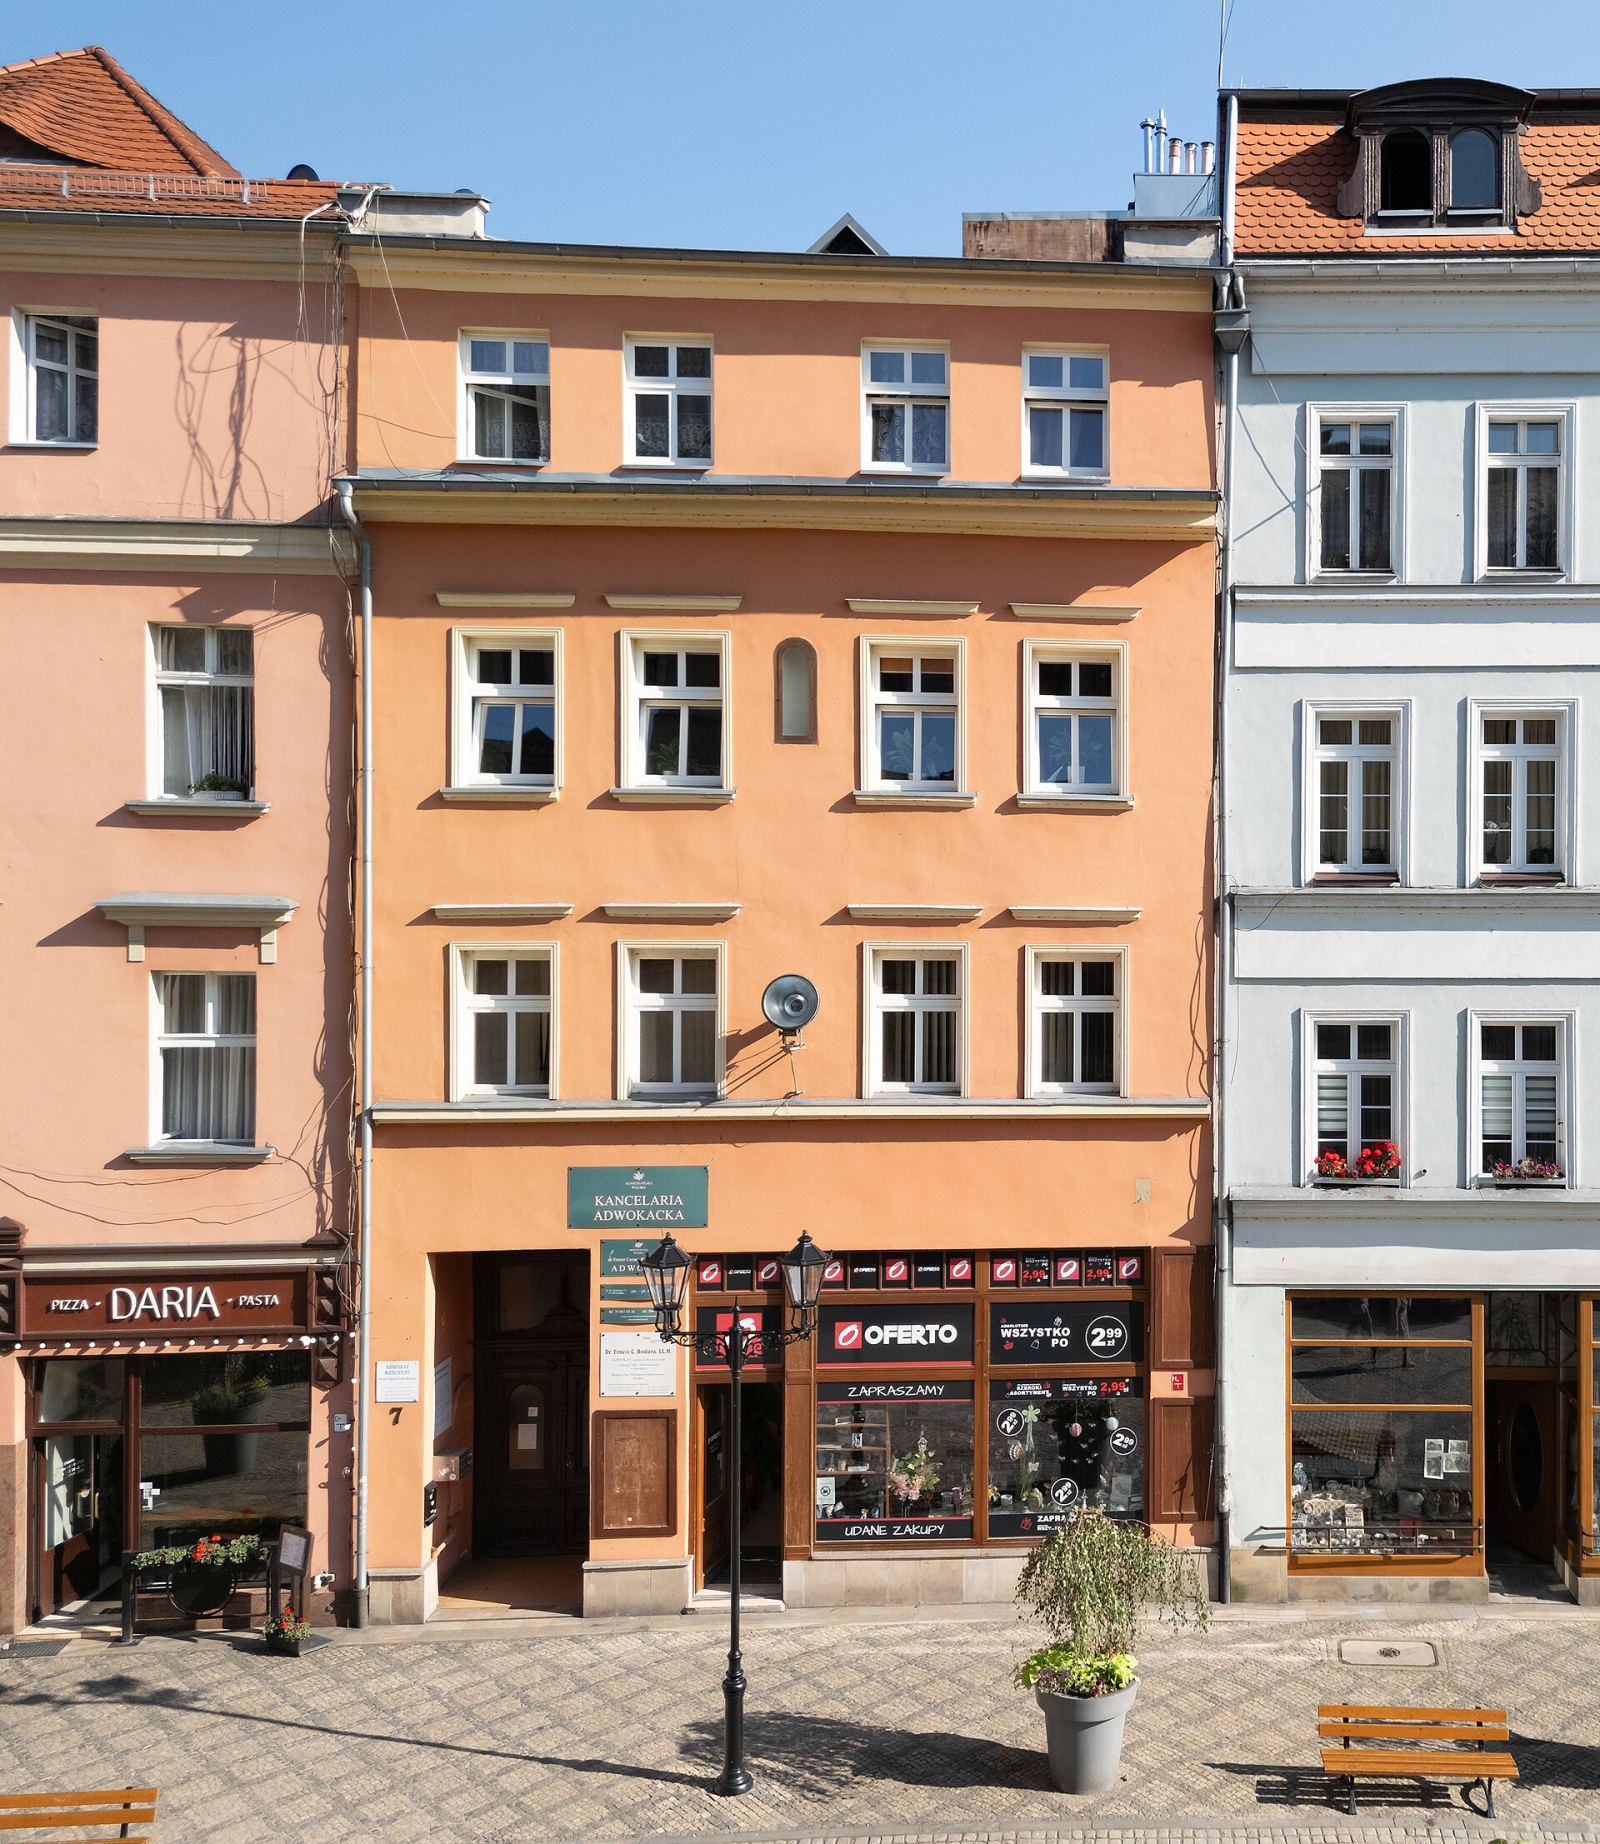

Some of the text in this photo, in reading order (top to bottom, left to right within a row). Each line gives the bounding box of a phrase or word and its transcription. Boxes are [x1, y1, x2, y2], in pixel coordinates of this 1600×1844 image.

[595, 1195, 684, 1206] KANCELARIA
[593, 1209, 684, 1221] ADWOKACKA
[1023, 1269, 1045, 1280] 2,99
[1087, 1268, 1110, 1279] 2,99
[51, 1286, 280, 1320] PIZZA DARIA PASTA
[864, 1324, 958, 1346] OFERTO
[1000, 1327, 1071, 1338] WSZYSTKO
[1051, 1338, 1069, 1348] PO
[1106, 1338, 1116, 1347] zł
[847, 1384, 945, 1397] ZAPRASZAMY
[1100, 1382, 1126, 1393] 2,99
[388, 1407, 403, 1427] 7
[844, 1524, 944, 1537] UDANE ZAKUPY
